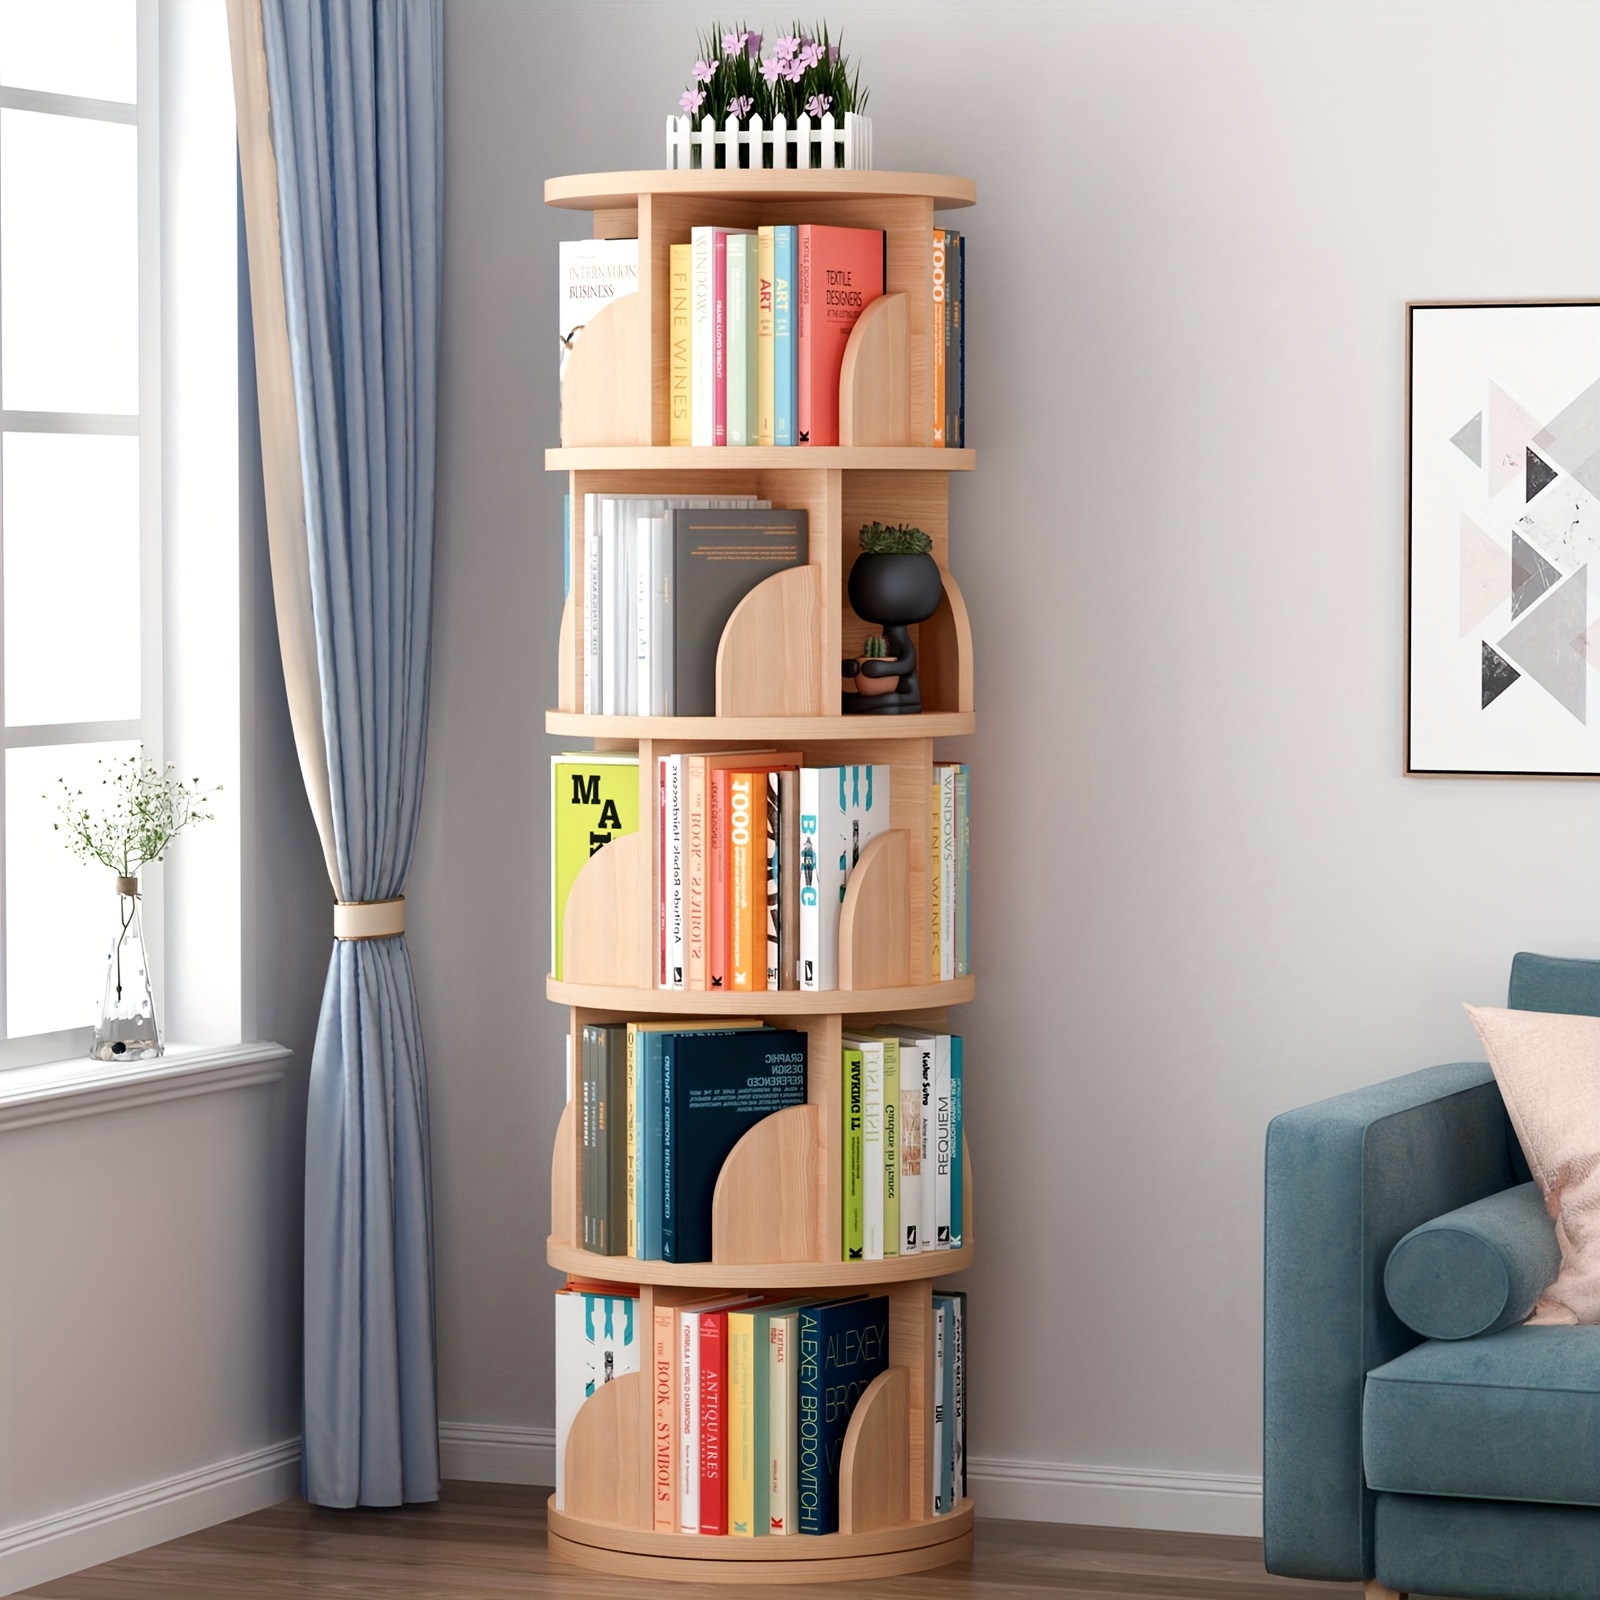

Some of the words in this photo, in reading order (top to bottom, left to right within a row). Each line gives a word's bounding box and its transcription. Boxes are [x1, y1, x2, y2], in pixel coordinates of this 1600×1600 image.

[570, 264, 638, 280] INTERNATION
[570, 284, 614, 299] BUSINESS
[696, 235, 708, 324] WINDOWS
[760, 279, 772, 312] ART
[776, 278, 788, 312] ART
[826, 270, 852, 287] TEXTILE
[826, 290, 862, 307] DESIGNERS
[673, 273, 687, 326] FINE
[673, 339, 688, 419] WINES
[944, 774, 953, 862] WINDOWS
[938, 1096, 948, 1176] REQUIEM
[801, 1314, 818, 1391] ALEXEY
[825, 1324, 886, 1370] ALEXEY
[657, 1360, 670, 1406] BOOK
[706, 1370, 718, 1479] ANTIQUAIRES
[657, 1422, 670, 1502] SYMBOLS
[801, 1396, 818, 1522] BRODOVITCH
